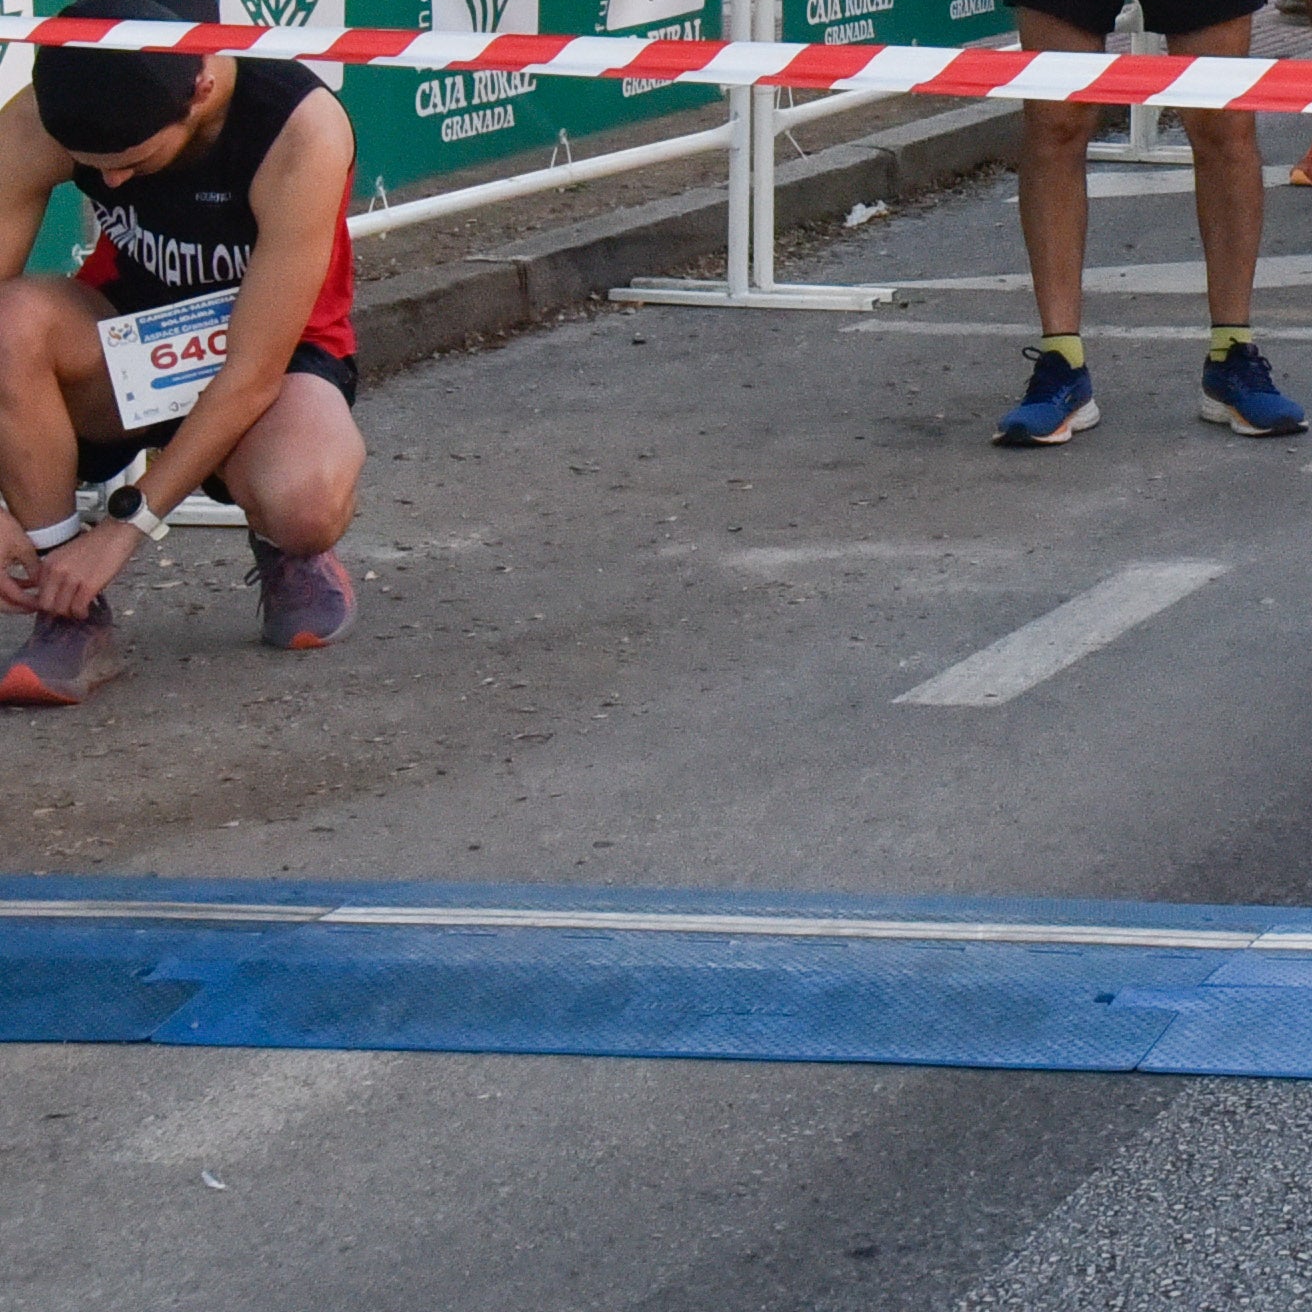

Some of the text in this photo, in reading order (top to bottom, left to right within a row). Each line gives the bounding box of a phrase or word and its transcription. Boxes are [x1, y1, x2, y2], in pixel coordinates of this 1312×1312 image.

[824, 19, 875, 46] GRANADA
[415, 74, 468, 117] CAJA
[440, 105, 516, 143] GRANADA
[143, 326, 181, 343] ASPACE
